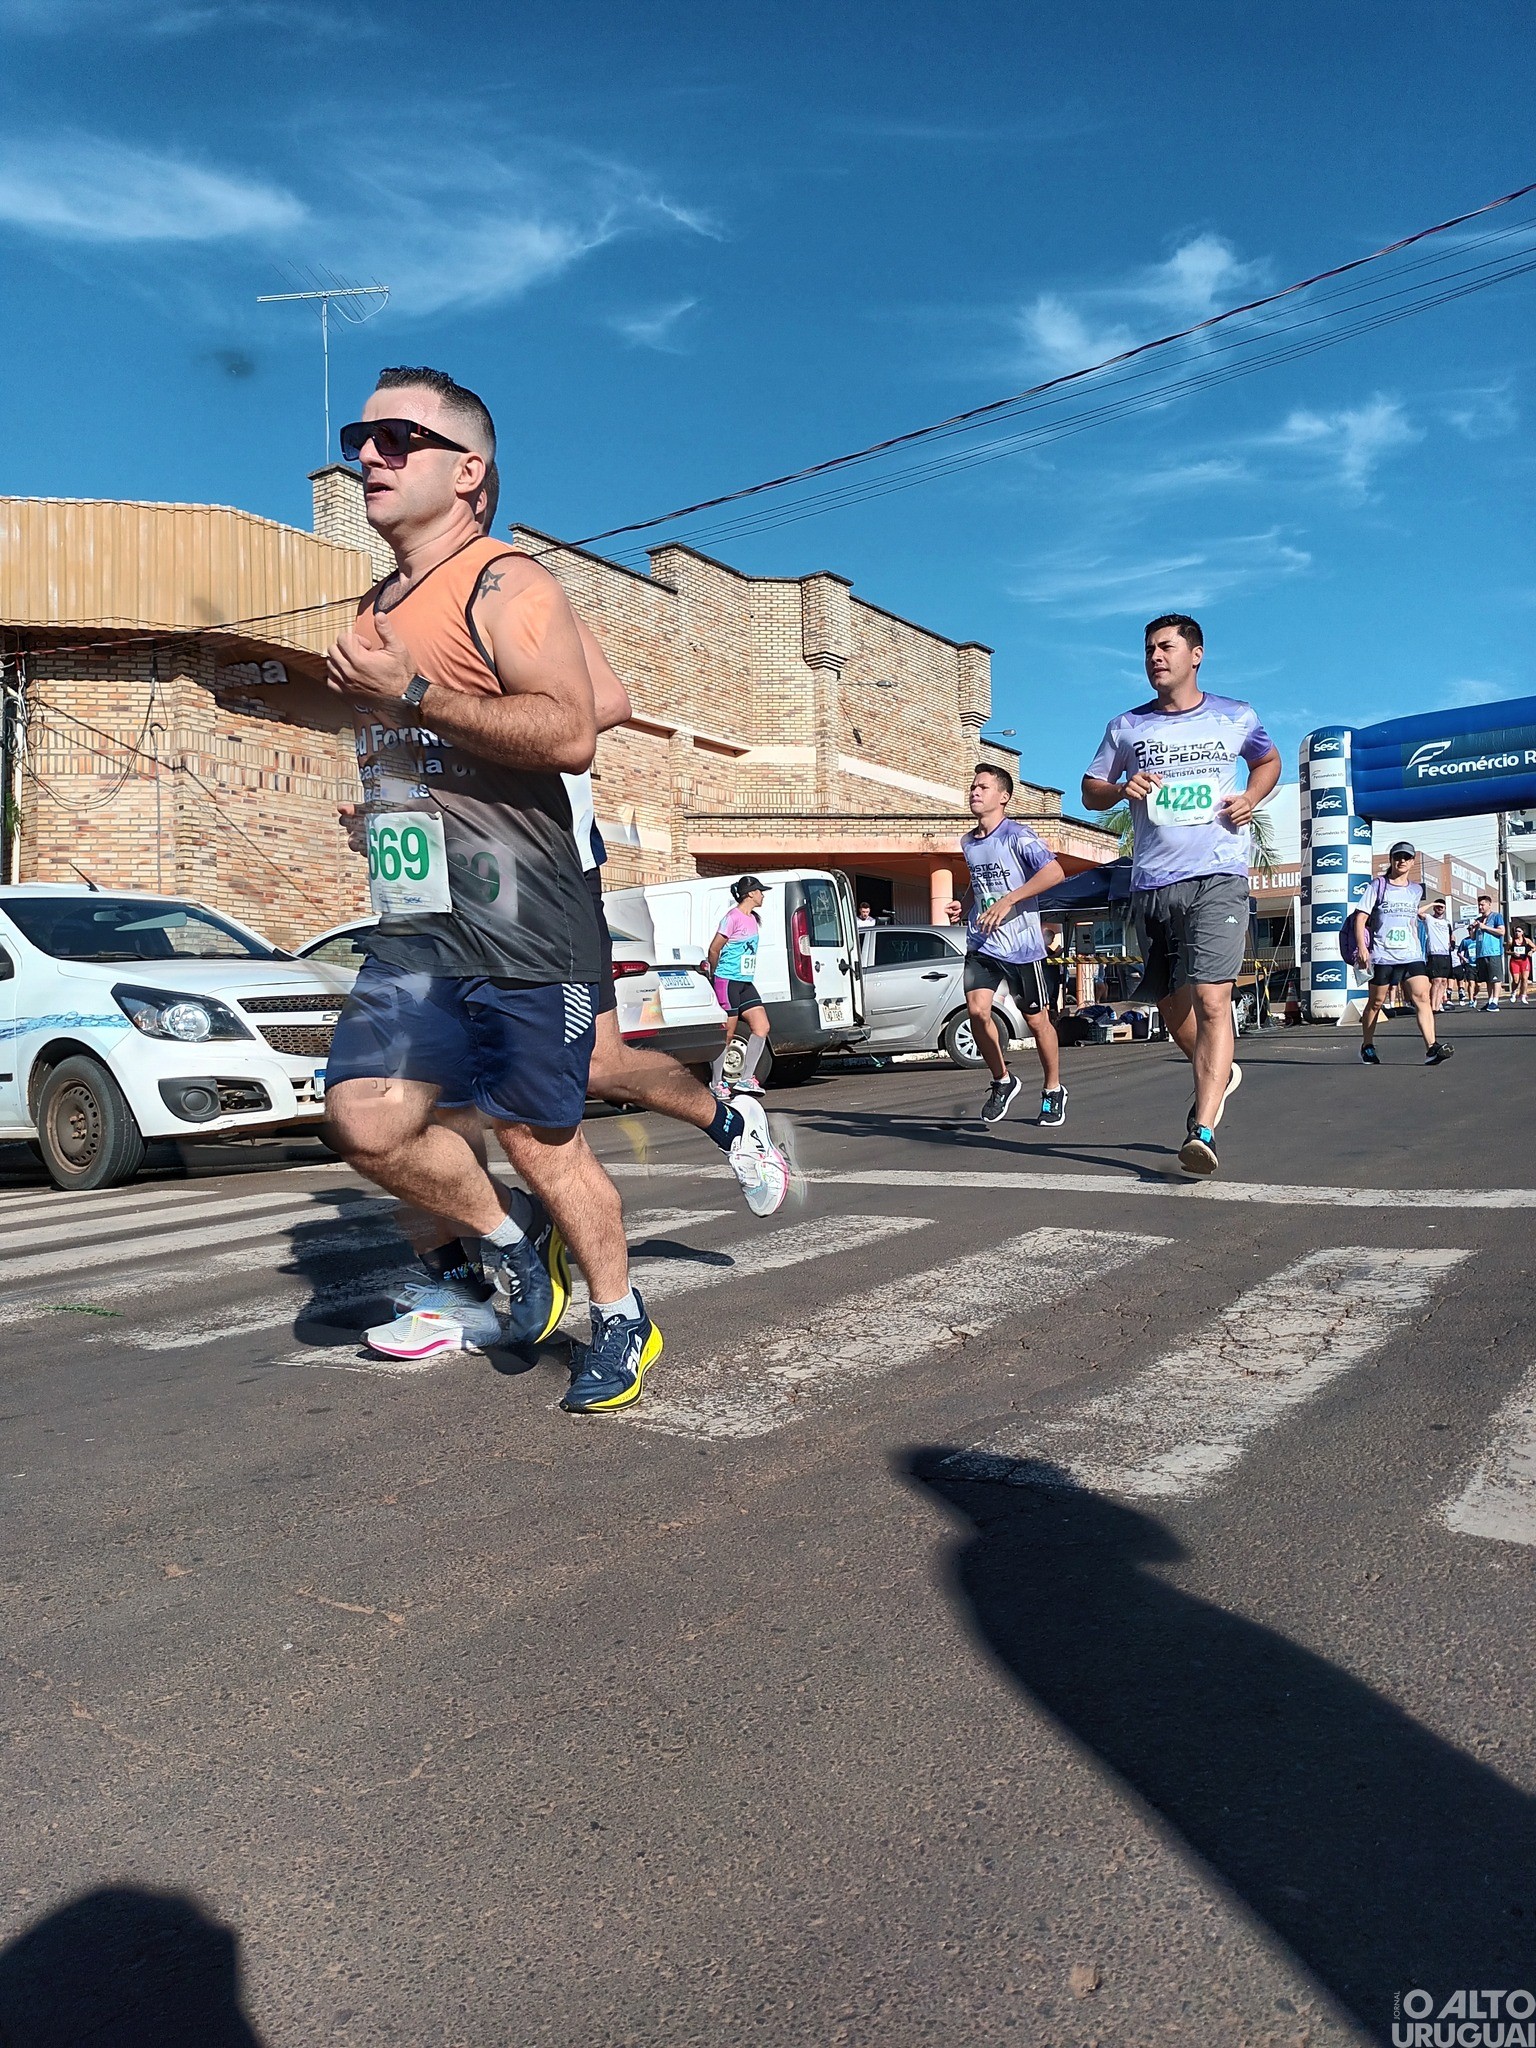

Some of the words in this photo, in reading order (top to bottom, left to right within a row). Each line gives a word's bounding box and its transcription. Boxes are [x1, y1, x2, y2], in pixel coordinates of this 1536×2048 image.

[1138, 755, 1165, 769] DAS
[1418, 754, 1519, 778] Fecomércio
[369, 827, 430, 881] 669
[1386, 929, 1406, 942] 439
